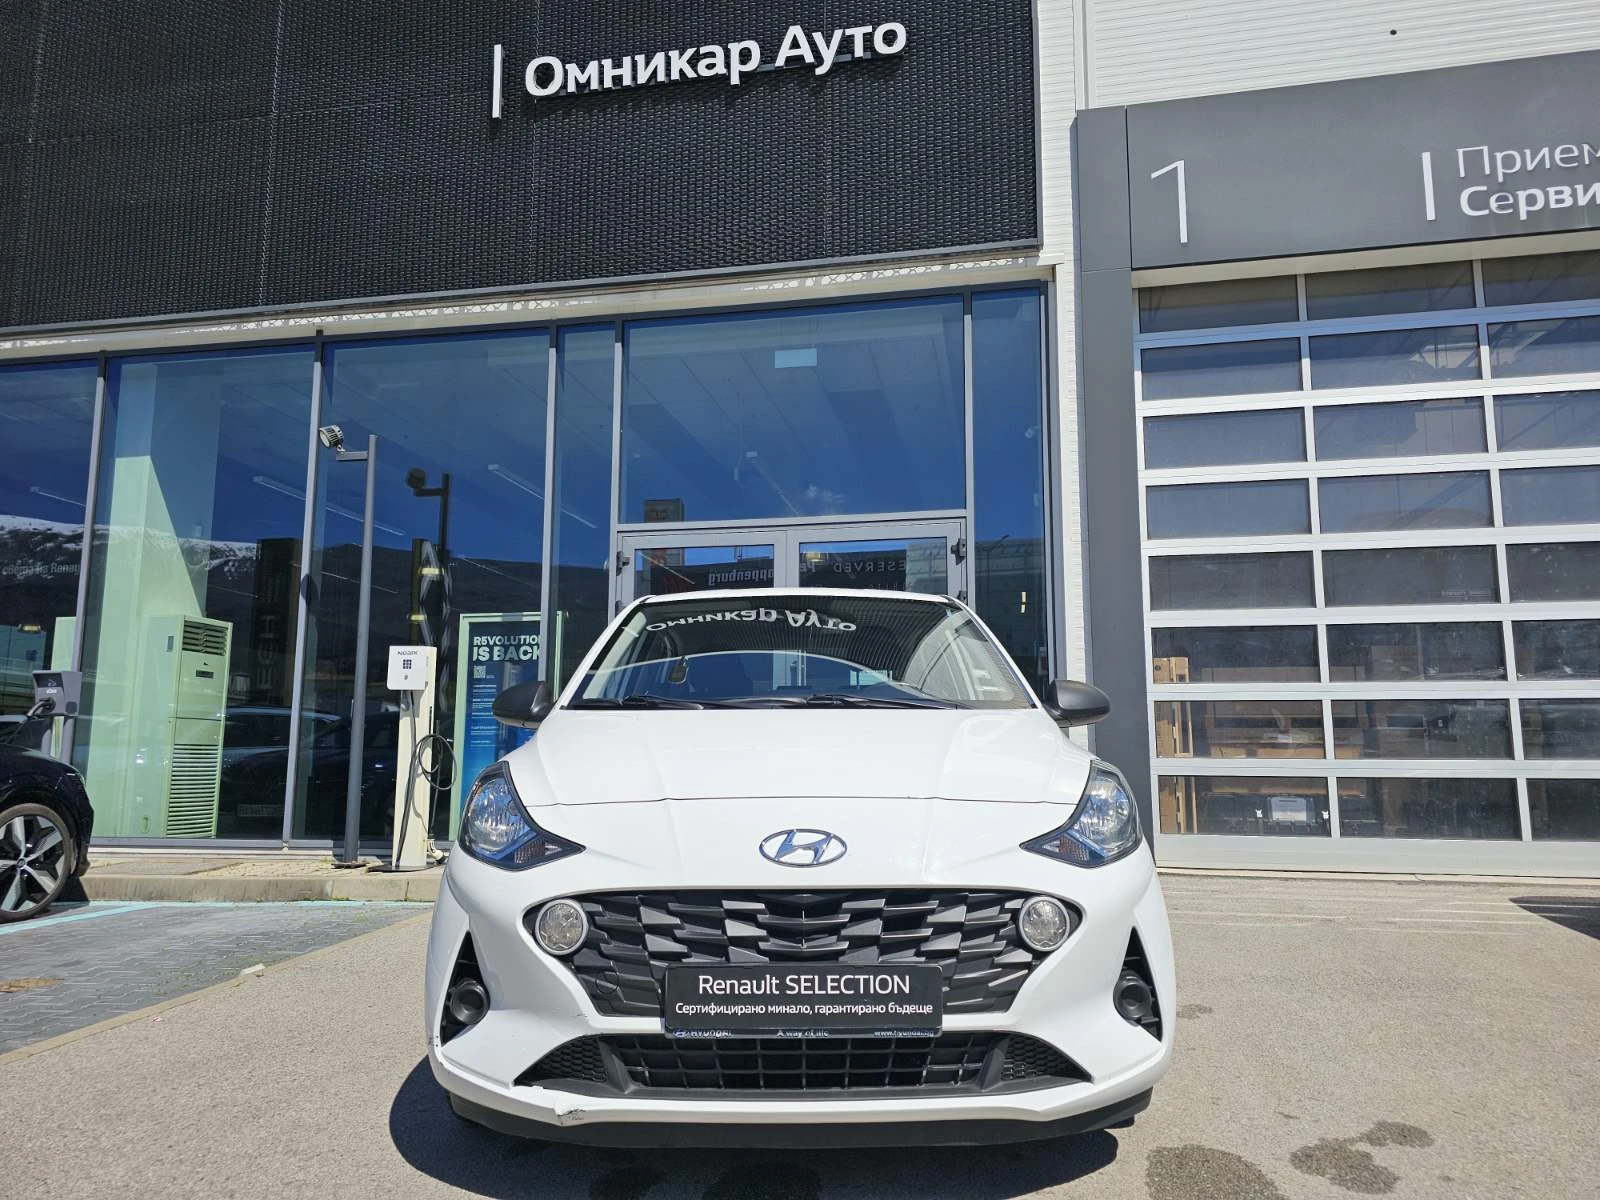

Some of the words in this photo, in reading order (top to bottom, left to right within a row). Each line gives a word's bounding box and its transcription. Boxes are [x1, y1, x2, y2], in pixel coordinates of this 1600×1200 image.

[525, 38, 761, 97] Омникар
[774, 21, 907, 75] Ауто
[1151, 159, 1188, 244] 1
[1459, 182, 1600, 221] Серви
[473, 634, 540, 646] R5VOLUTIO
[472, 646, 490, 662] IS
[698, 974, 780, 995] Renault
[785, 974, 910, 995] SELECTION
[675, 1002, 766, 1016] Сертифицирано
[767, 1004, 813, 1016] минало,
[815, 1004, 886, 1016] гарантирано
[888, 1002, 933, 1015] бъдеще
